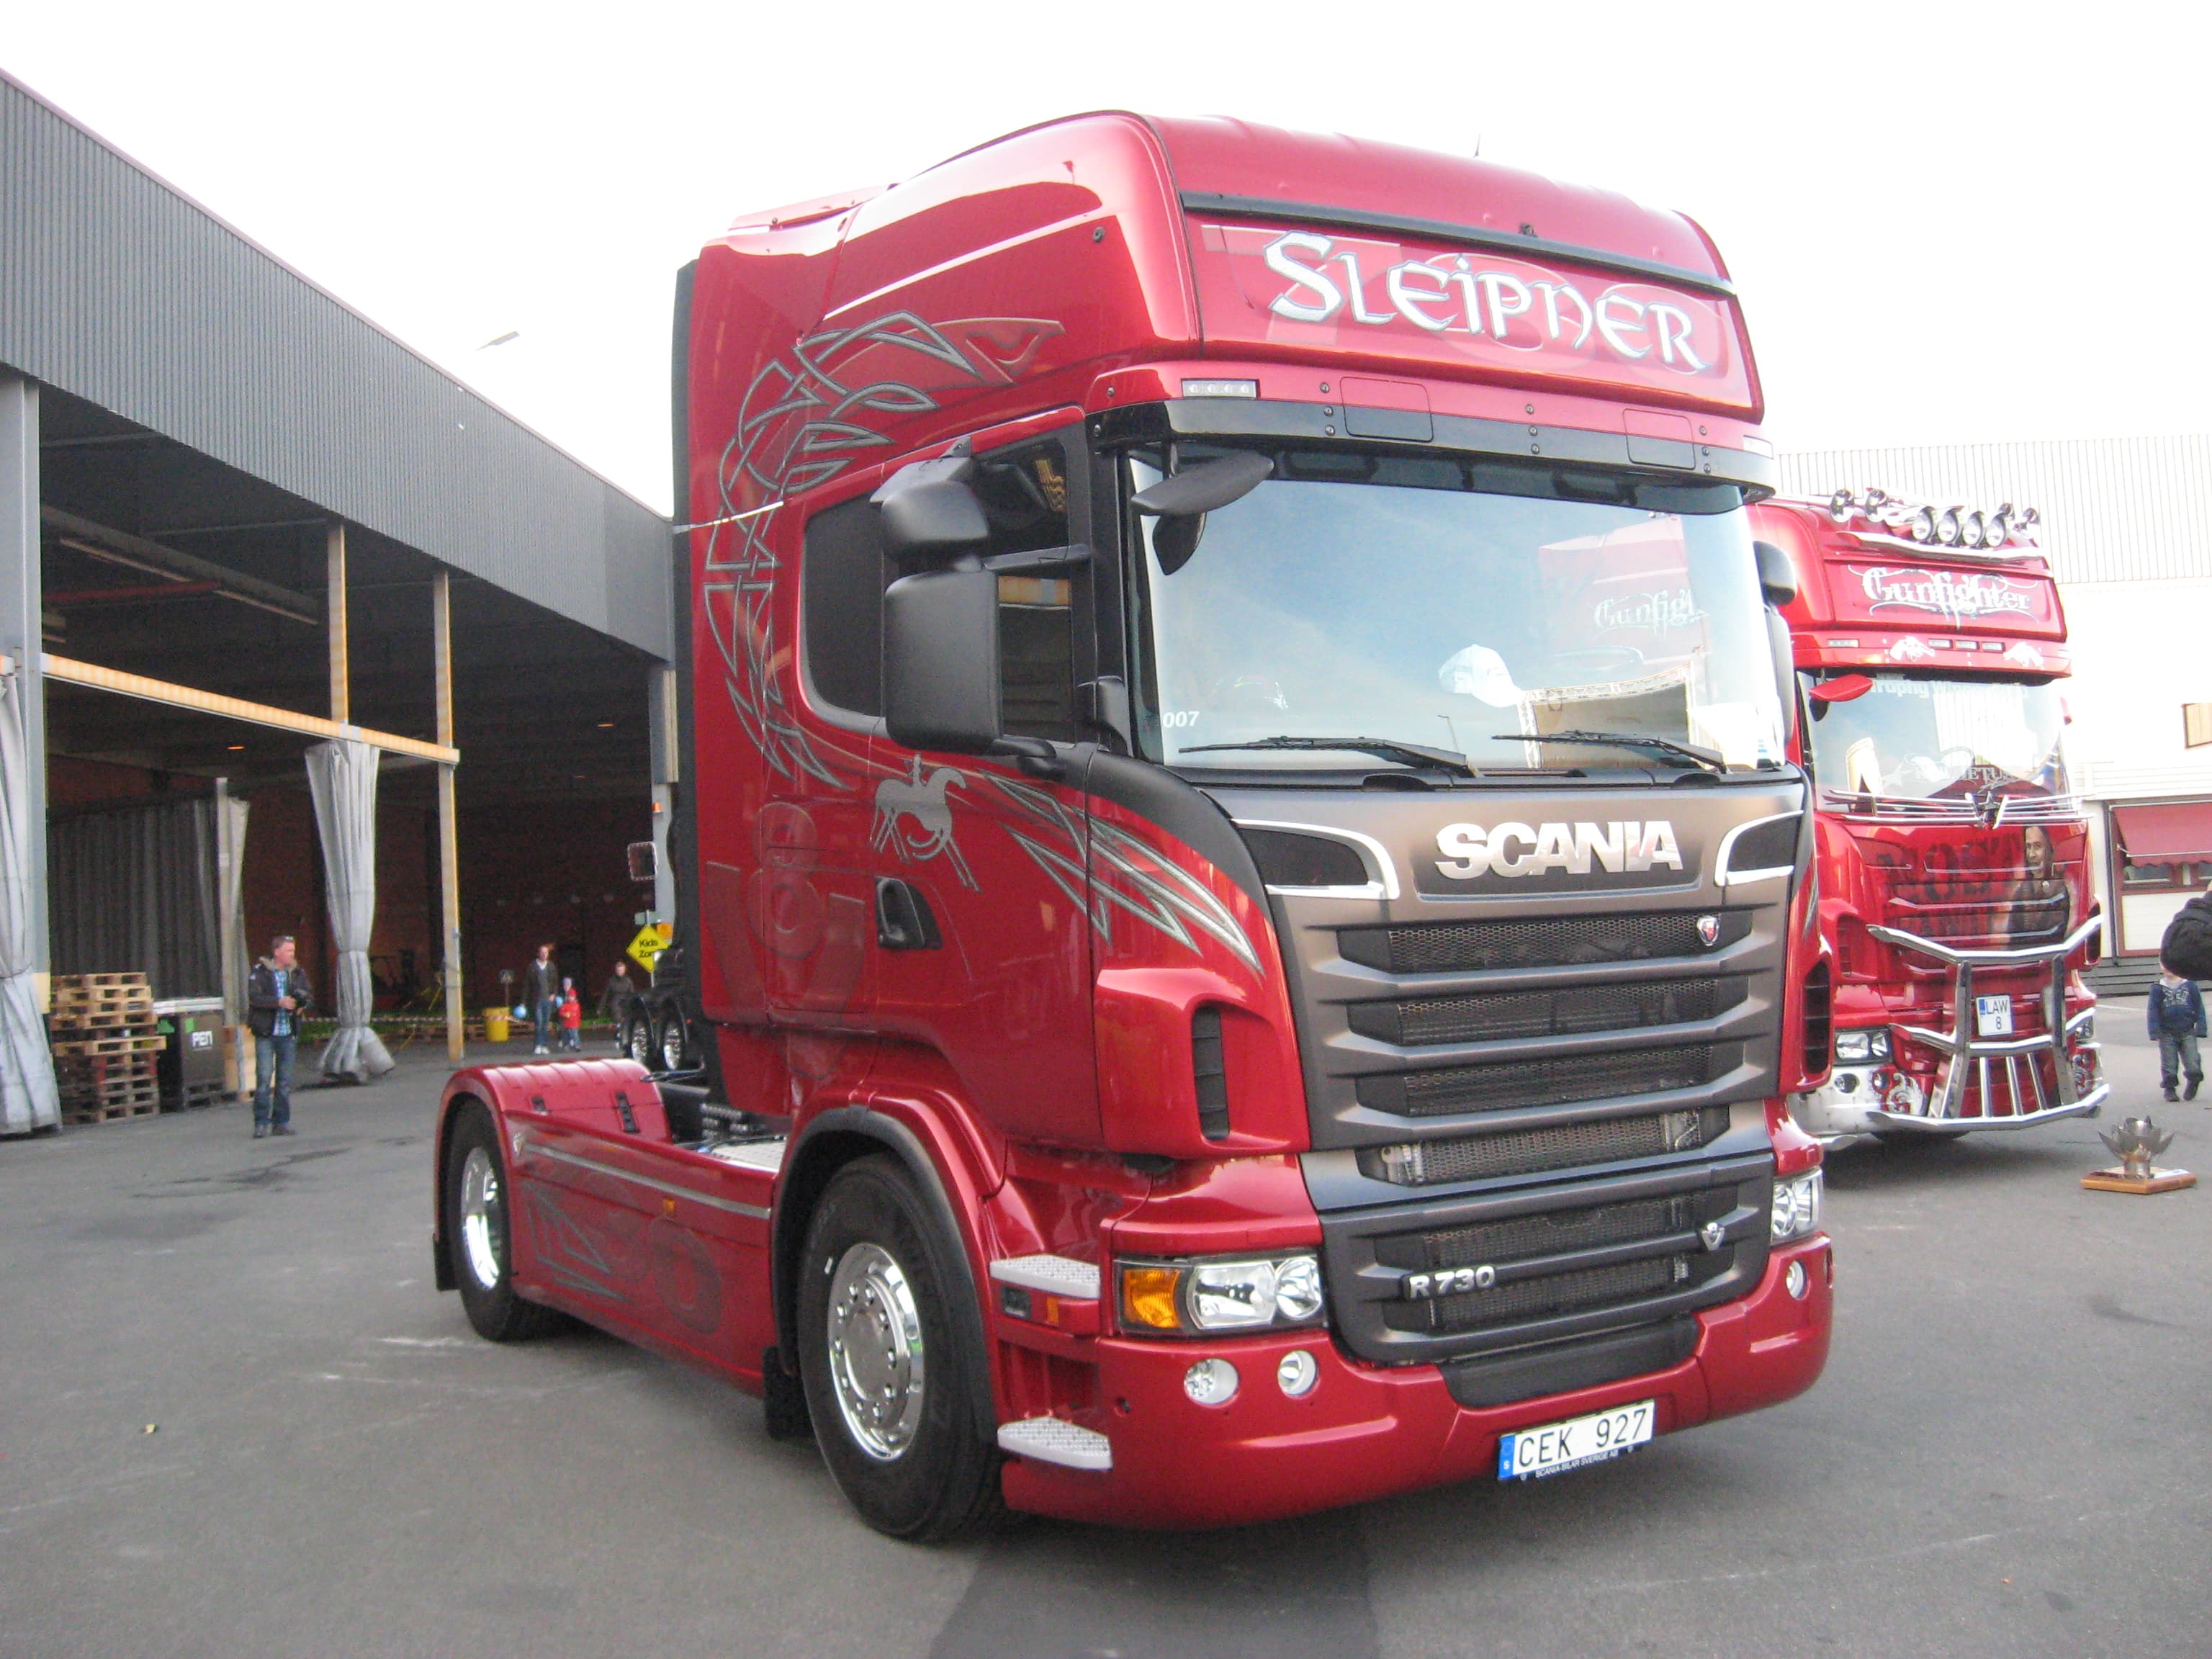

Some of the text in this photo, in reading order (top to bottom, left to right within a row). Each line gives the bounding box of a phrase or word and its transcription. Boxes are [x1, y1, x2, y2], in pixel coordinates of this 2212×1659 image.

[1861, 566, 2033, 624] Gunfighter
[1162, 710, 1200, 728] 007
[1435, 820, 1683, 880] SCANIA
[639, 939, 658, 948] Kids
[1986, 999, 2008, 1015] LAW
[1995, 1016, 2002, 1030] 8
[1409, 1265, 1496, 1299] R 730
[1519, 1408, 1647, 1467] CEK 927
